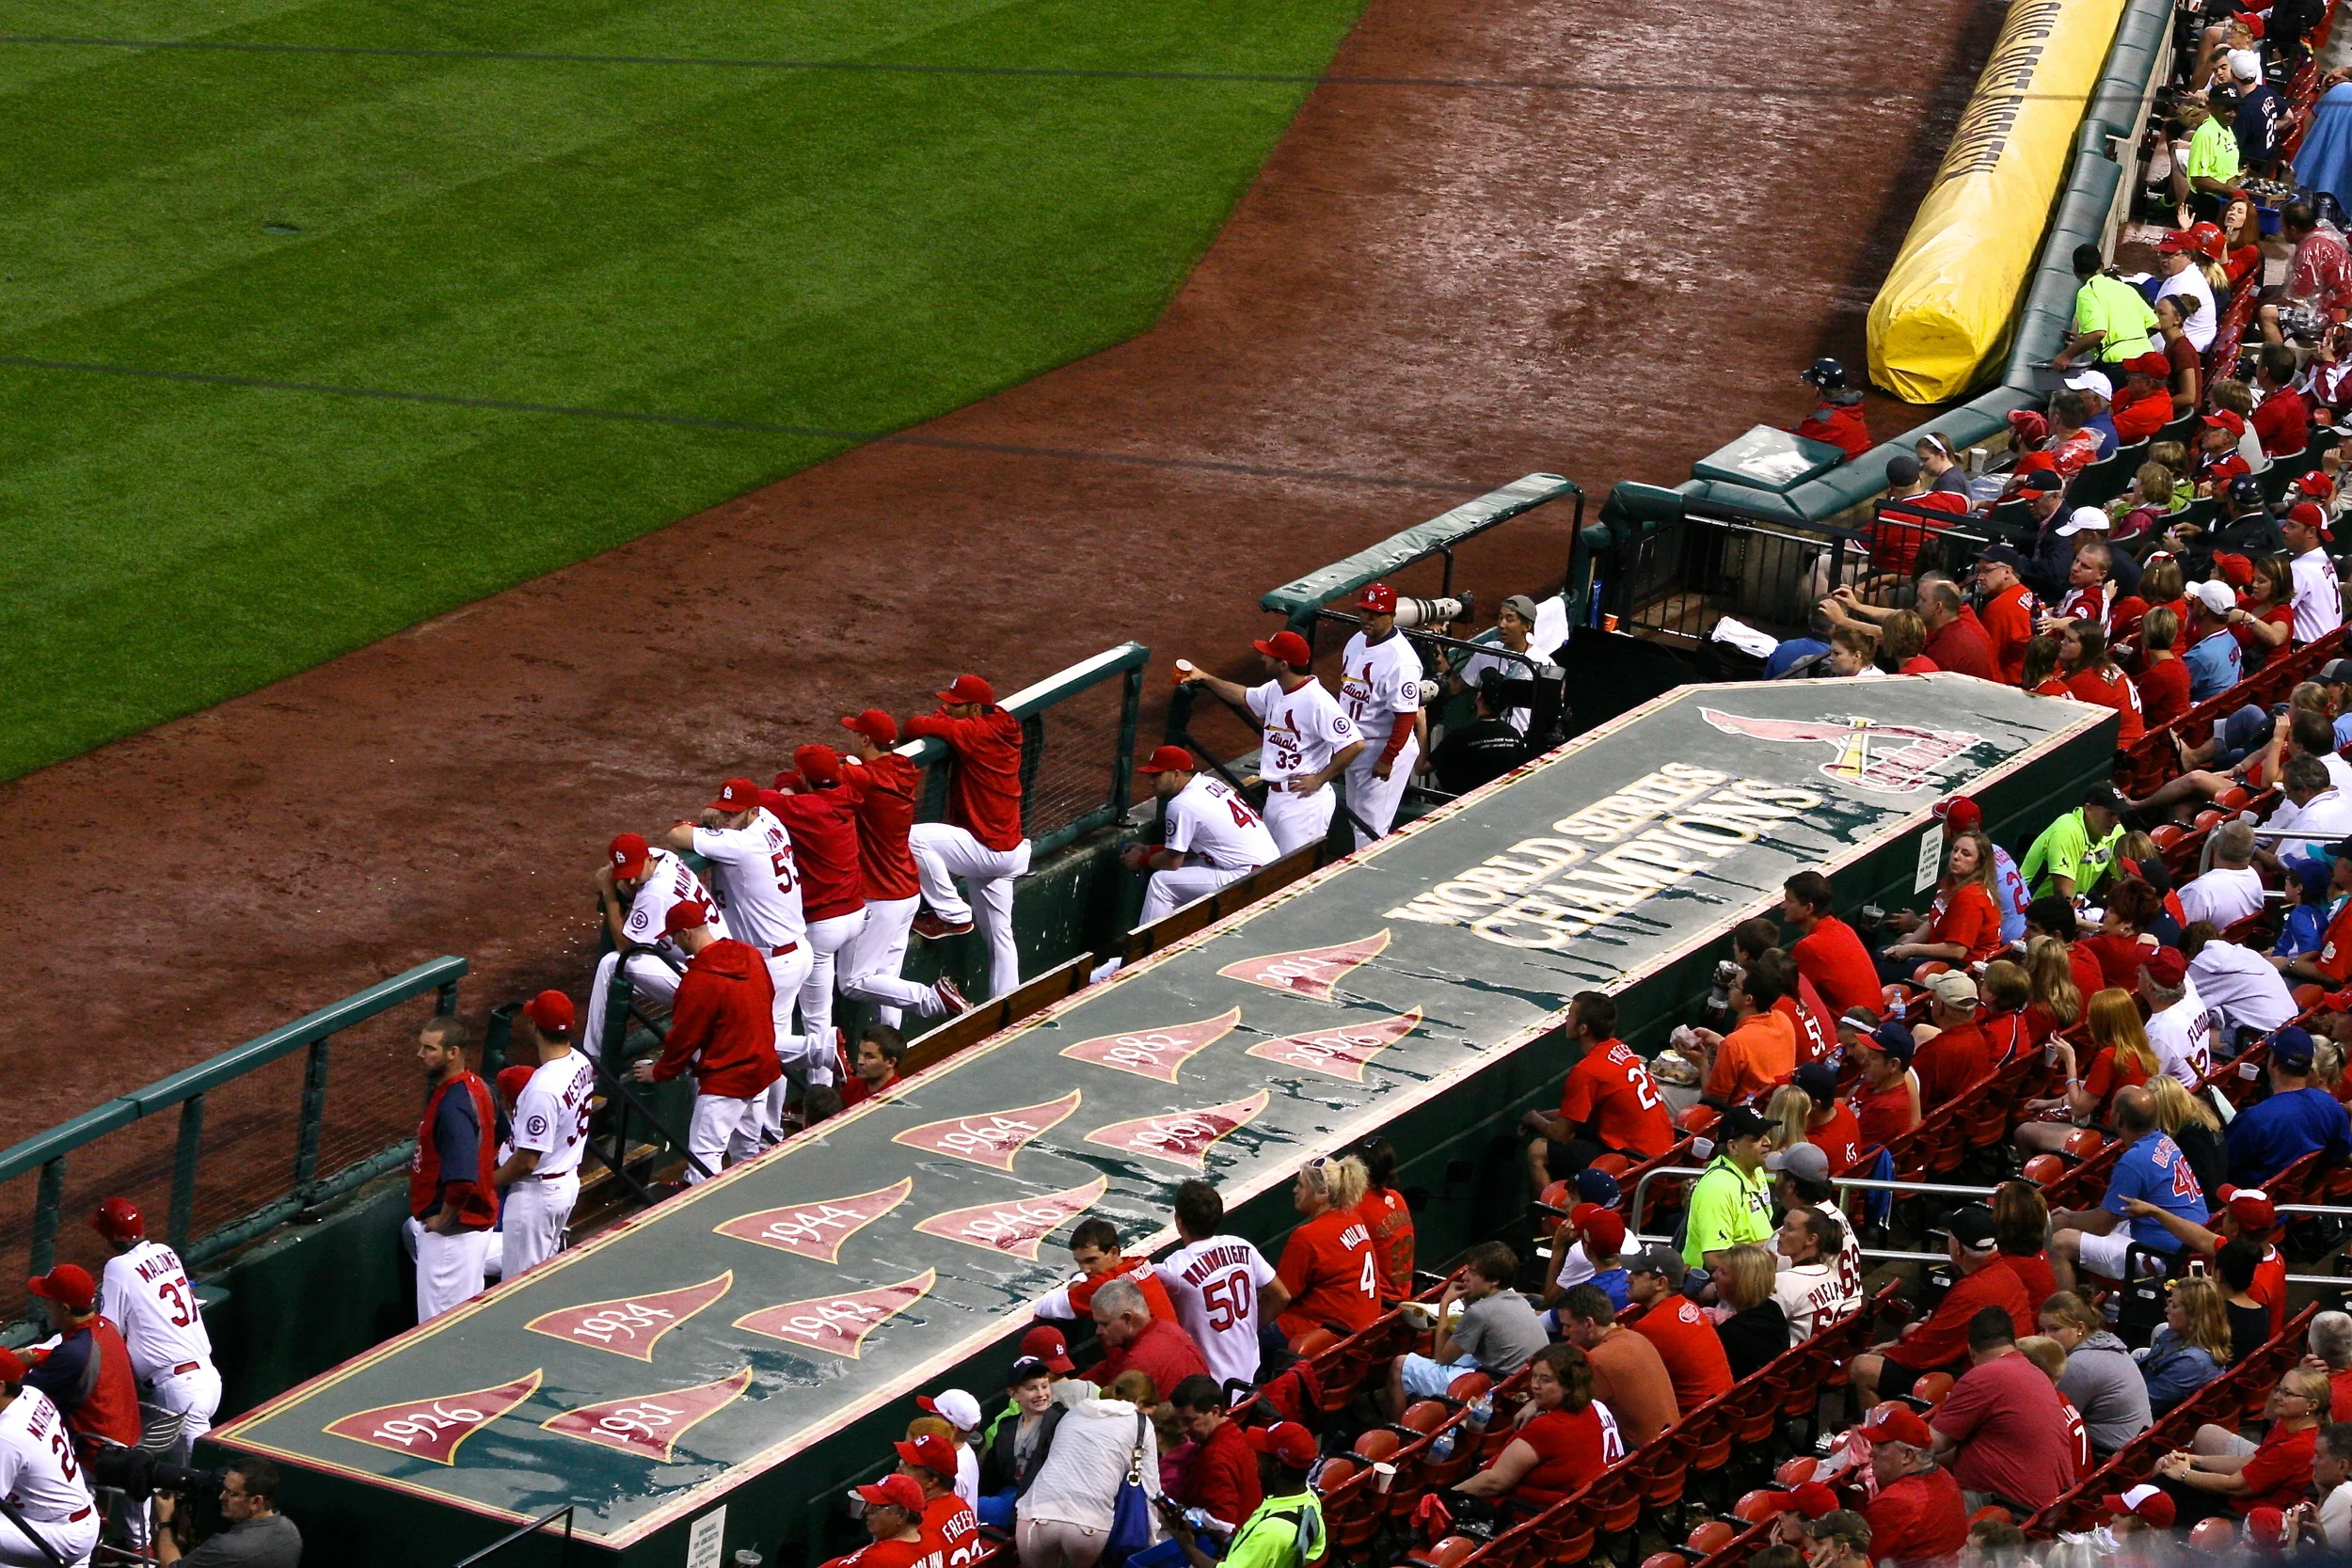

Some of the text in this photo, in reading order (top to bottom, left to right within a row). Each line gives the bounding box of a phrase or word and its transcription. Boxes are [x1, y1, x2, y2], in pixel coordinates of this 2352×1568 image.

[1349, 700, 1363, 721] 11
[1276, 751, 1302, 770] 33
[1381, 761, 1729, 927] WORLD SERIES
[1470, 778, 1823, 950] CHAMPIONS
[2007, 867, 2031, 914] 2
[1256, 956, 1339, 987] 2011
[1103, 1034, 1193, 1068] 1982
[1285, 1030, 1383, 1067] 2006
[936, 1116, 1039, 1155] 1964
[1129, 1117, 1217, 1153] 1967
[761, 1205, 867, 1245] 1944
[961, 1203, 1064, 1243] 1946
[1182, 1245, 1250, 1289] WAINWRIGHT
[1360, 1251, 1376, 1299] 4
[782, 1301, 881, 1339] 1942
[1202, 1270, 1250, 1334] 50
[573, 1303, 675, 1343] 1934
[373, 1402, 485, 1447] 1926
[590, 1402, 686, 1442] 1931
